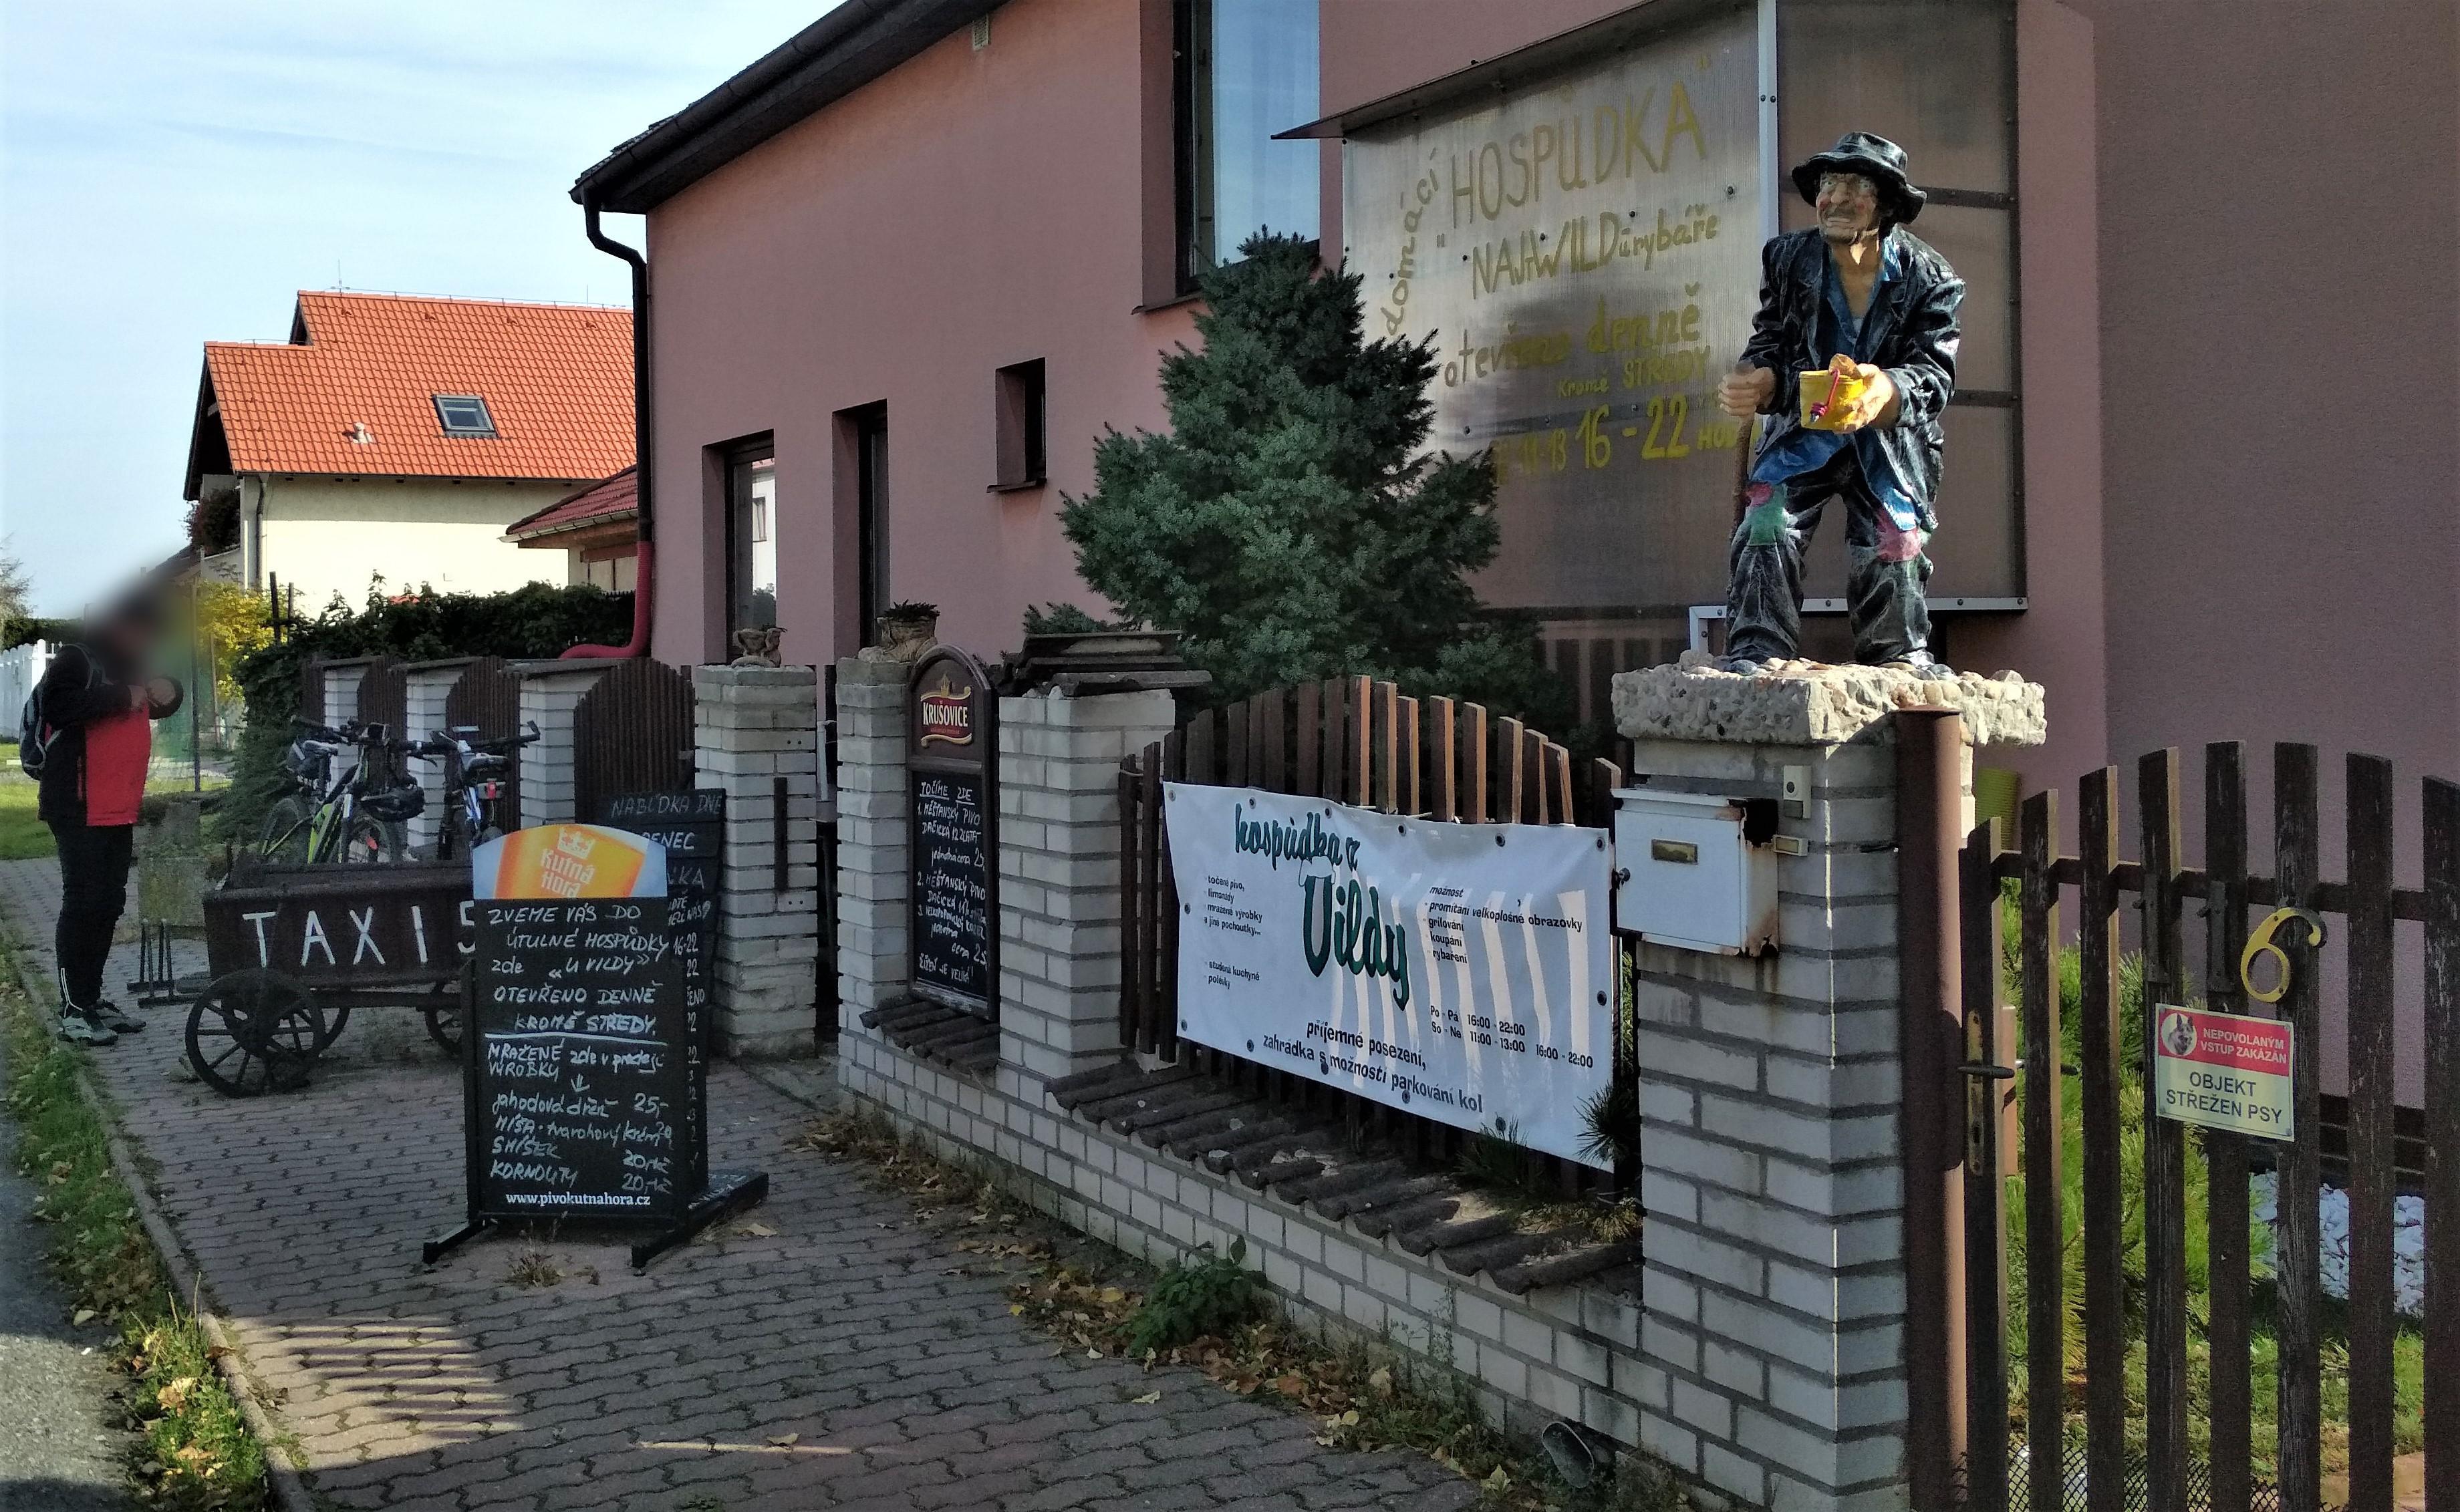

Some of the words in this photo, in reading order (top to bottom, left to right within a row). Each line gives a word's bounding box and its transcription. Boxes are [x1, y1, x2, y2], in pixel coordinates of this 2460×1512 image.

[1575, 402, 1611, 470] 16
[1641, 393, 1691, 461] 22
[923, 701, 968, 728] KRUŠOVICE
[962, 808, 980, 825] PIVO
[969, 881, 986, 901] PIVO
[1429, 886, 1465, 899] možnost
[487, 906, 559, 924] ZVEME
[604, 904, 642, 920] DO
[1235, 909, 1262, 923] výrobky
[1528, 914, 1583, 933] obrazovky
[242, 905, 428, 968] TAXI
[507, 926, 580, 949] ÚTULNÉ
[2240, 907, 2322, 1003] 6
[493, 982, 587, 1004] OTEVŘENO
[597, 979, 664, 1004] DENNĚ
[1430, 1005, 1440, 1018] Po
[1467, 1014, 1490, 1029] 16:00
[1499, 1020, 1526, 1036] 22:00
[1306, 1019, 1364, 1048] příjemné
[1369, 1037, 1427, 1071] posezení,
[1431, 1021, 1442, 1034] So
[1450, 1026, 1462, 1039] Ne
[1470, 1030, 1492, 1046] 11:00
[1500, 1037, 1526, 1053] 13:00
[1536, 1044, 1558, 1060] 16:00
[1568, 1052, 1594, 1068] 22:00
[2203, 1027, 2285, 1050] NEPOVOLANÝM
[2201, 1040, 2235, 1056] VSTUP
[2236, 1046, 2287, 1064] ZAKÁZÁN
[1262, 1034, 1315, 1061] zahrádka
[1319, 1050, 1327, 1064] s
[1391, 1074, 1454, 1105] parkování
[1458, 1089, 1483, 1113] kol
[2189, 1071, 2257, 1097] OBJEKT
[2166, 1086, 2243, 1118] STŘEŽEN
[2247, 1103, 2282, 1124] PSY
[505, 1191, 651, 1207] www.pivokutnahora.cz
